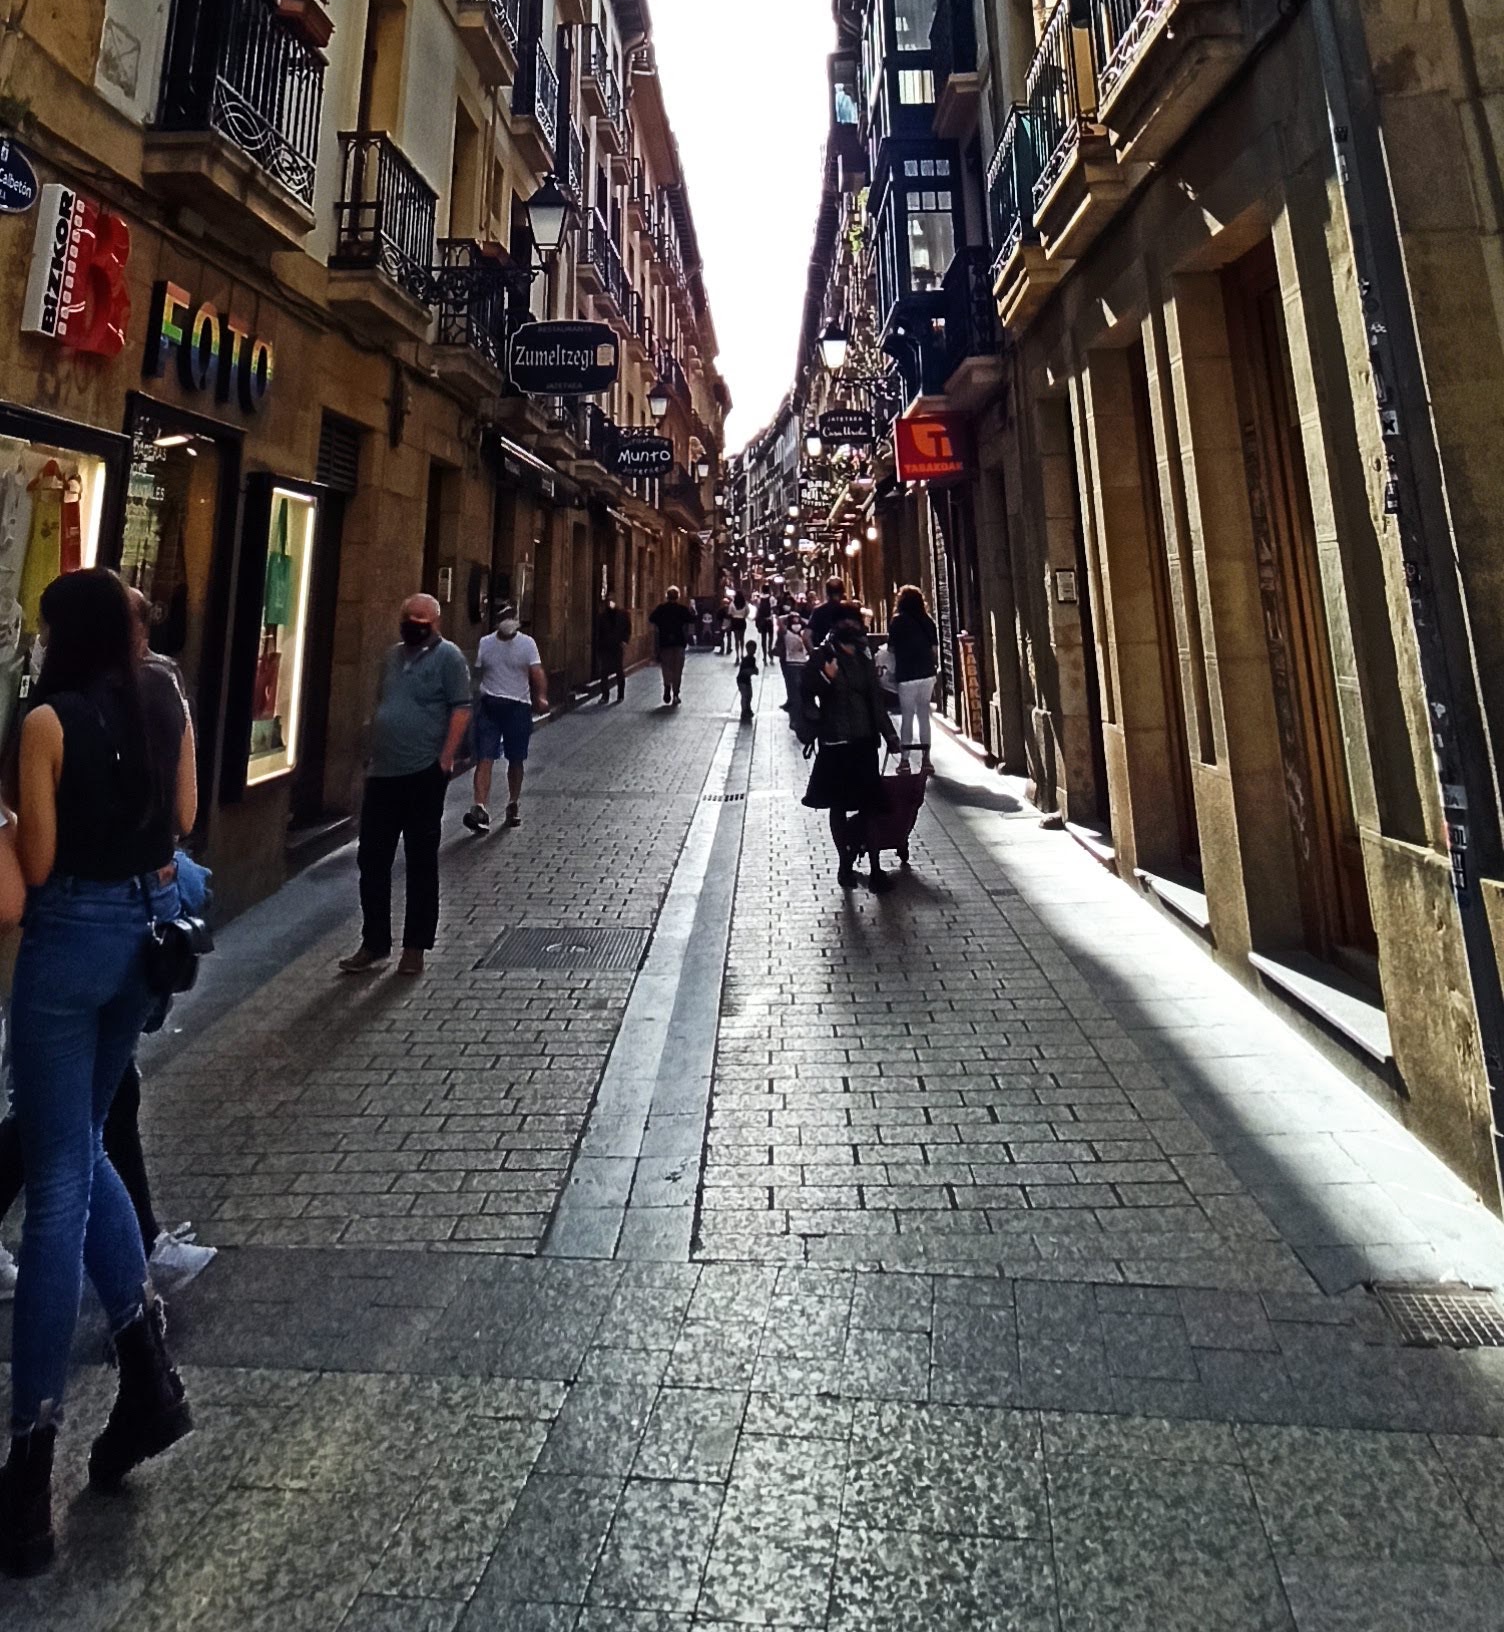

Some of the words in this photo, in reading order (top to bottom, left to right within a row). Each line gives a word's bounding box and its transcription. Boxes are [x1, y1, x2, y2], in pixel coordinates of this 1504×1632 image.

[143, 281, 274, 410] FOTO
[514, 344, 594, 371] Zumeltzegi
[617, 448, 672, 465] Munto
